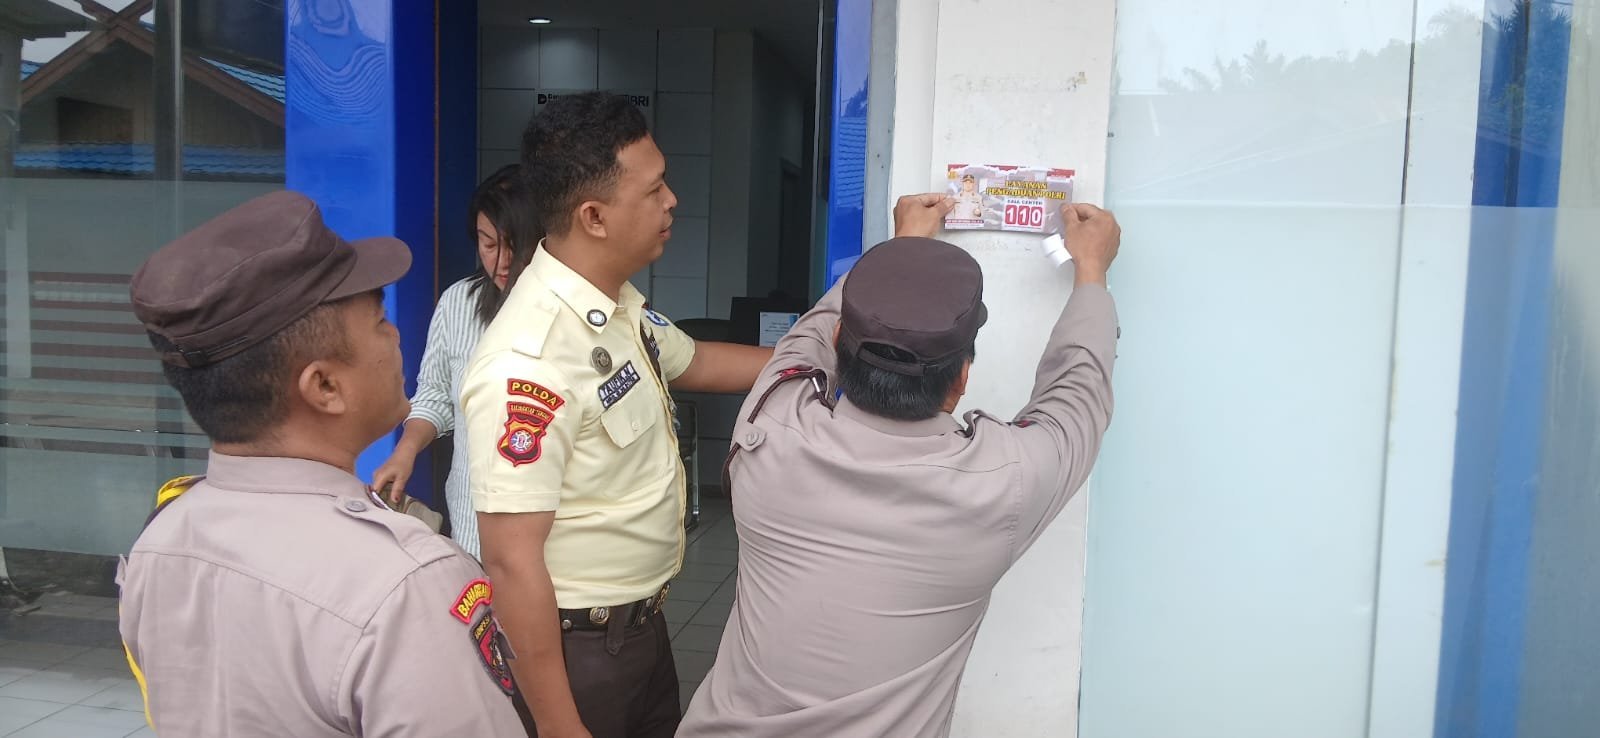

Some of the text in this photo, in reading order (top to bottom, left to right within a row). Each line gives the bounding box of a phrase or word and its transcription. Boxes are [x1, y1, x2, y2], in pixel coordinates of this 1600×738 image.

[1005, 180, 1048, 190] LAYANAN
[1006, 206, 1042, 225] 110
[511, 382, 557, 406] POLDA
